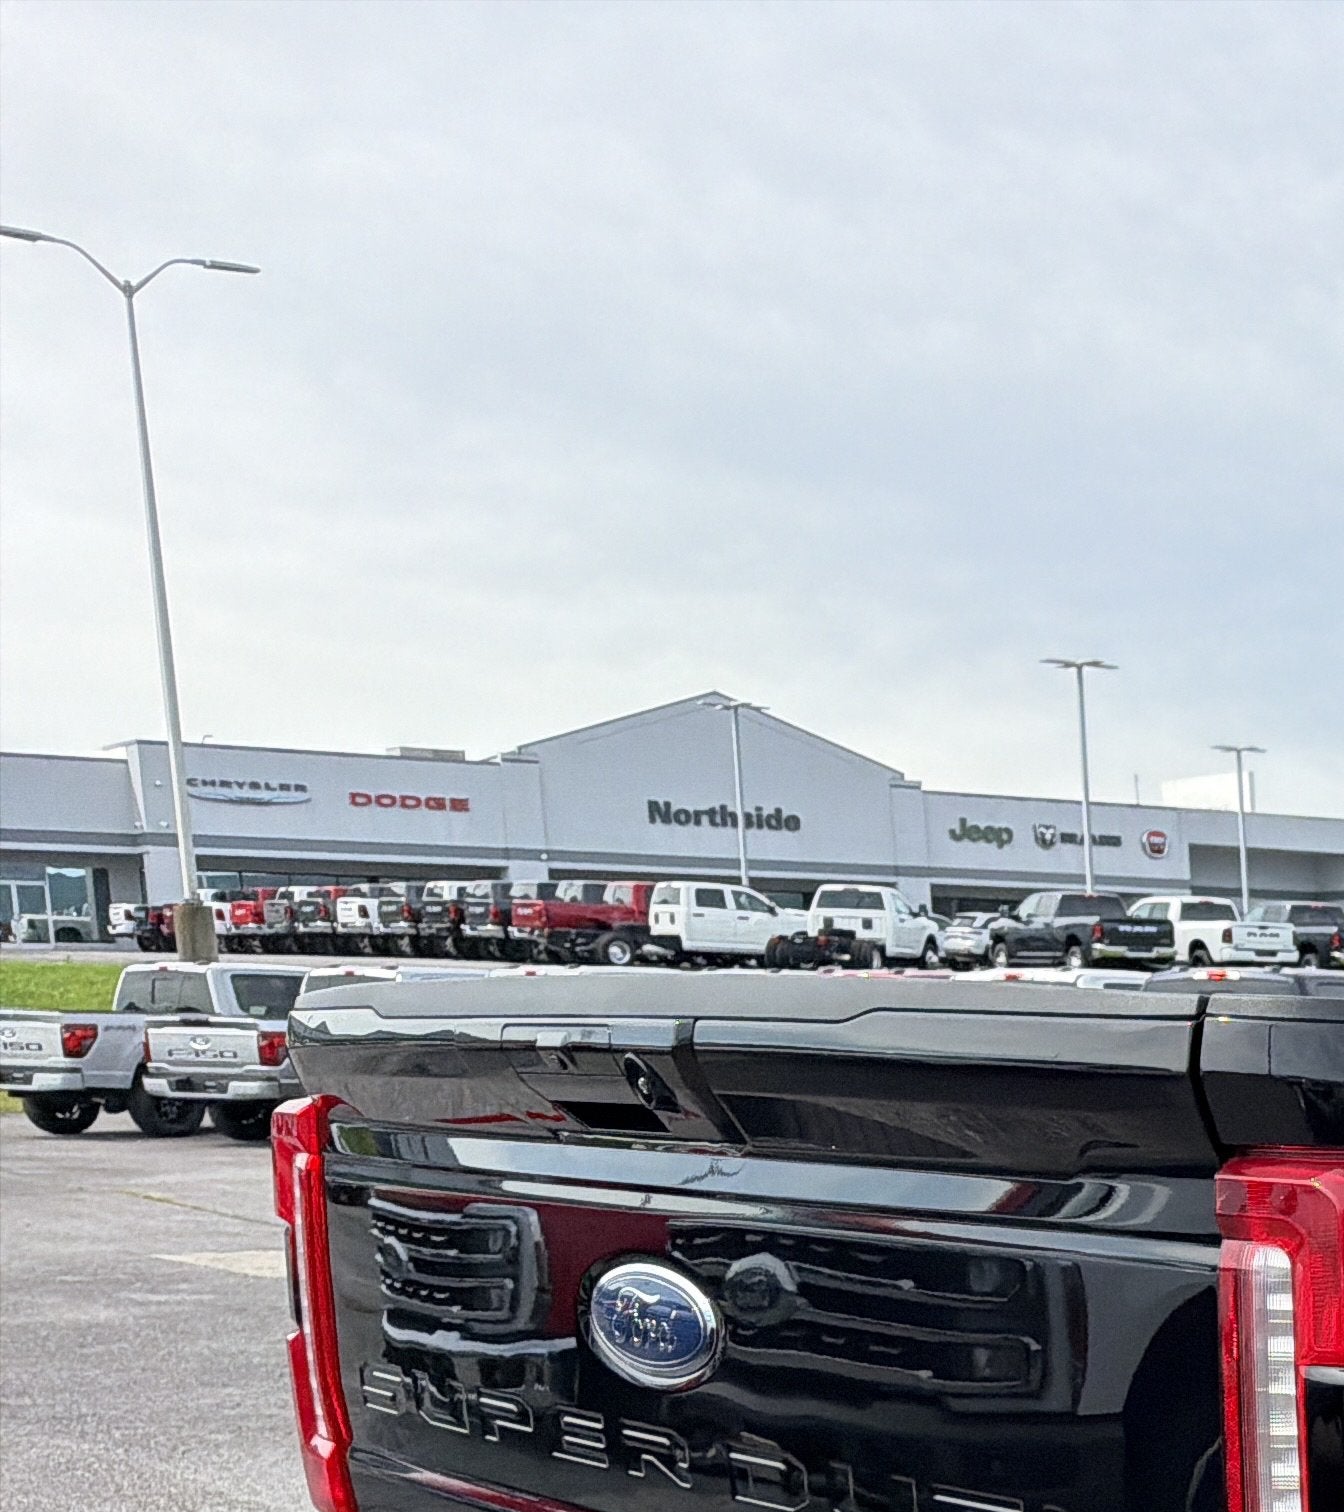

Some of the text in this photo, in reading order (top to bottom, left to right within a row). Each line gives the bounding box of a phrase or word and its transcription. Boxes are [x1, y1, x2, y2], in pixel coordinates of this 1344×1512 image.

[186, 777, 308, 793] CHRYSLER
[349, 791, 470, 812] DODGE
[647, 799, 801, 831] Northside
[949, 817, 1013, 849] Jeep
[611, 1286, 678, 1353] Ford
[361, 1361, 692, 1489] SUPER
